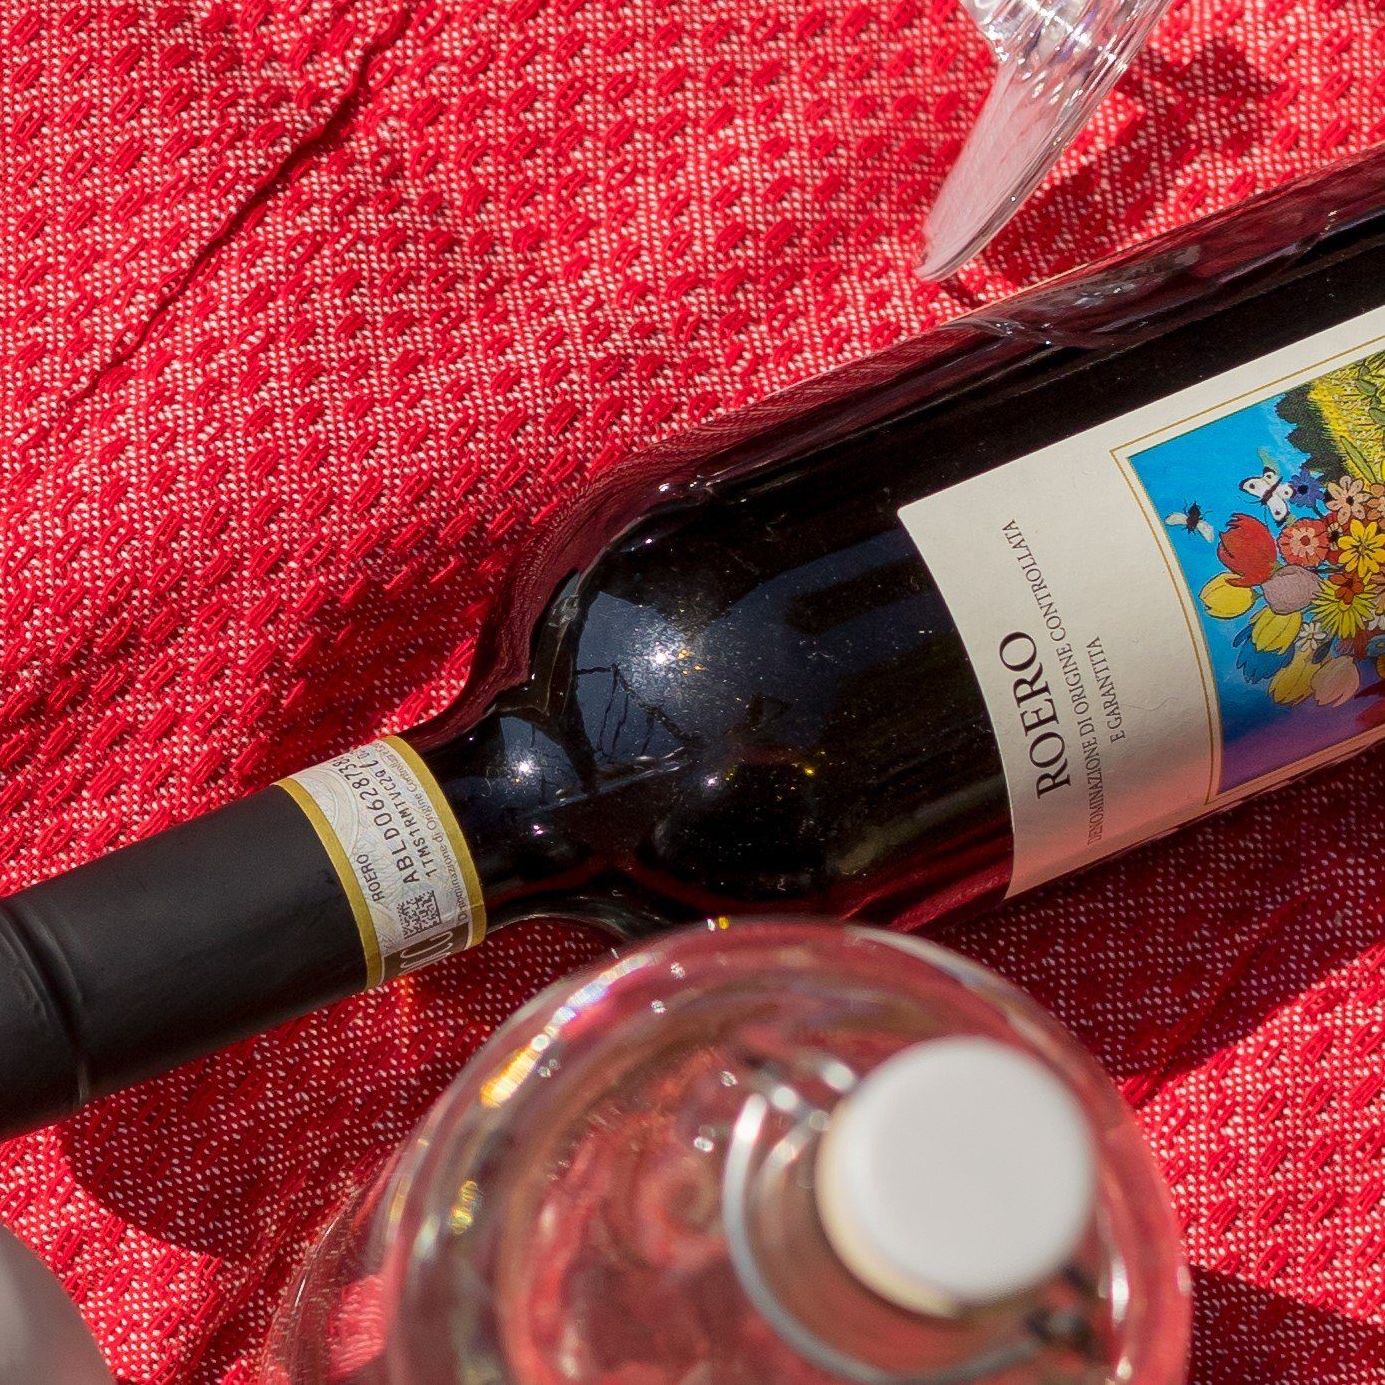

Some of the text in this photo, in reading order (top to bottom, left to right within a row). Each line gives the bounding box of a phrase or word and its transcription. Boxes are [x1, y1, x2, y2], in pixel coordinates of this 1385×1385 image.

[999, 631, 1072, 800] ROERO
[1002, 519, 1105, 845] DENOMINAZIONE DI ORIGINE CONTROLLATA
[1086, 636, 1127, 744] E GARANTITA
[354, 854, 386, 903] ROERO
